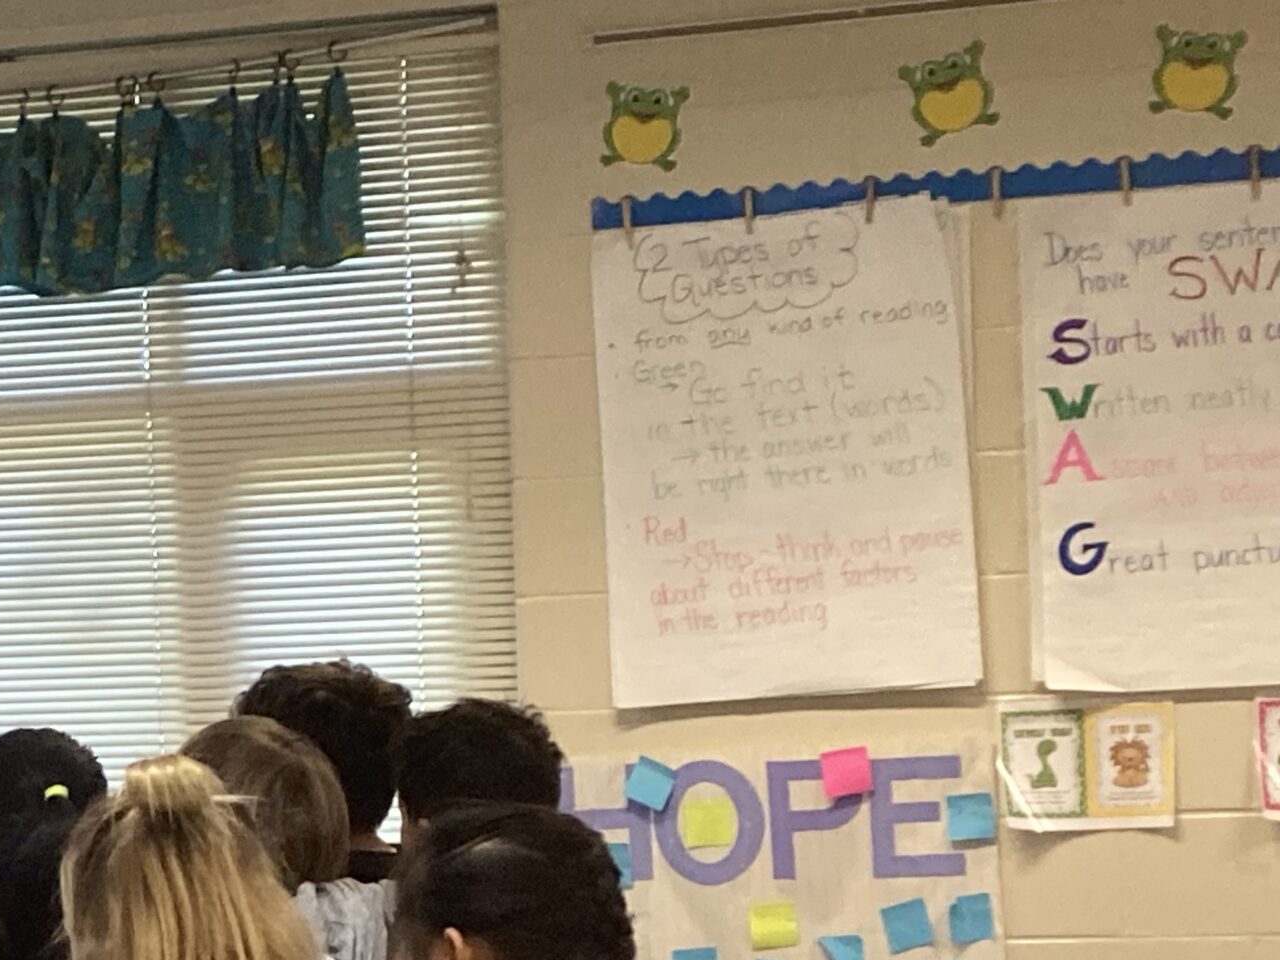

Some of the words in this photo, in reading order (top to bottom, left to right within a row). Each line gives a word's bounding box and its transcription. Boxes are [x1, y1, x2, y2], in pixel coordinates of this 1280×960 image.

[652, 247, 673, 272] 2
[682, 236, 769, 271] Types
[786, 221, 820, 257] of
[1044, 231, 1103, 266] Does
[1128, 234, 1177, 264] your
[671, 268, 820, 304] Questions
[1078, 267, 1130, 295] have
[633, 331, 689, 352] from
[708, 327, 751, 347] any
[769, 314, 813, 337] kind
[822, 305, 845, 329] of
[859, 299, 949, 326] reading
[1047, 318, 1157, 365] Starts
[1172, 311, 1225, 349] with
[1239, 324, 1253, 342] a
[632, 358, 707, 382] Green
[689, 376, 726, 406] Go
[741, 367, 807, 397] find
[822, 365, 856, 392] it
[681, 410, 735, 436] the
[758, 401, 819, 432] text
[1038, 383, 1168, 422] Written
[707, 437, 752, 464] the
[762, 432, 849, 461] answer
[871, 426, 912, 450] will
[652, 471, 678, 500] be
[698, 467, 750, 504] right
[764, 463, 832, 491] there
[842, 458, 868, 481] in
[884, 447, 953, 478] words
[642, 515, 688, 546] Red
[775, 532, 837, 563] think
[849, 527, 892, 554] and
[1057, 522, 1169, 577] Great
[649, 578, 709, 608] about
[727, 566, 826, 602] different
[840, 561, 919, 588] factors
[682, 608, 719, 632] the
[735, 602, 829, 633] reading
[560, 754, 967, 886] HOPE
